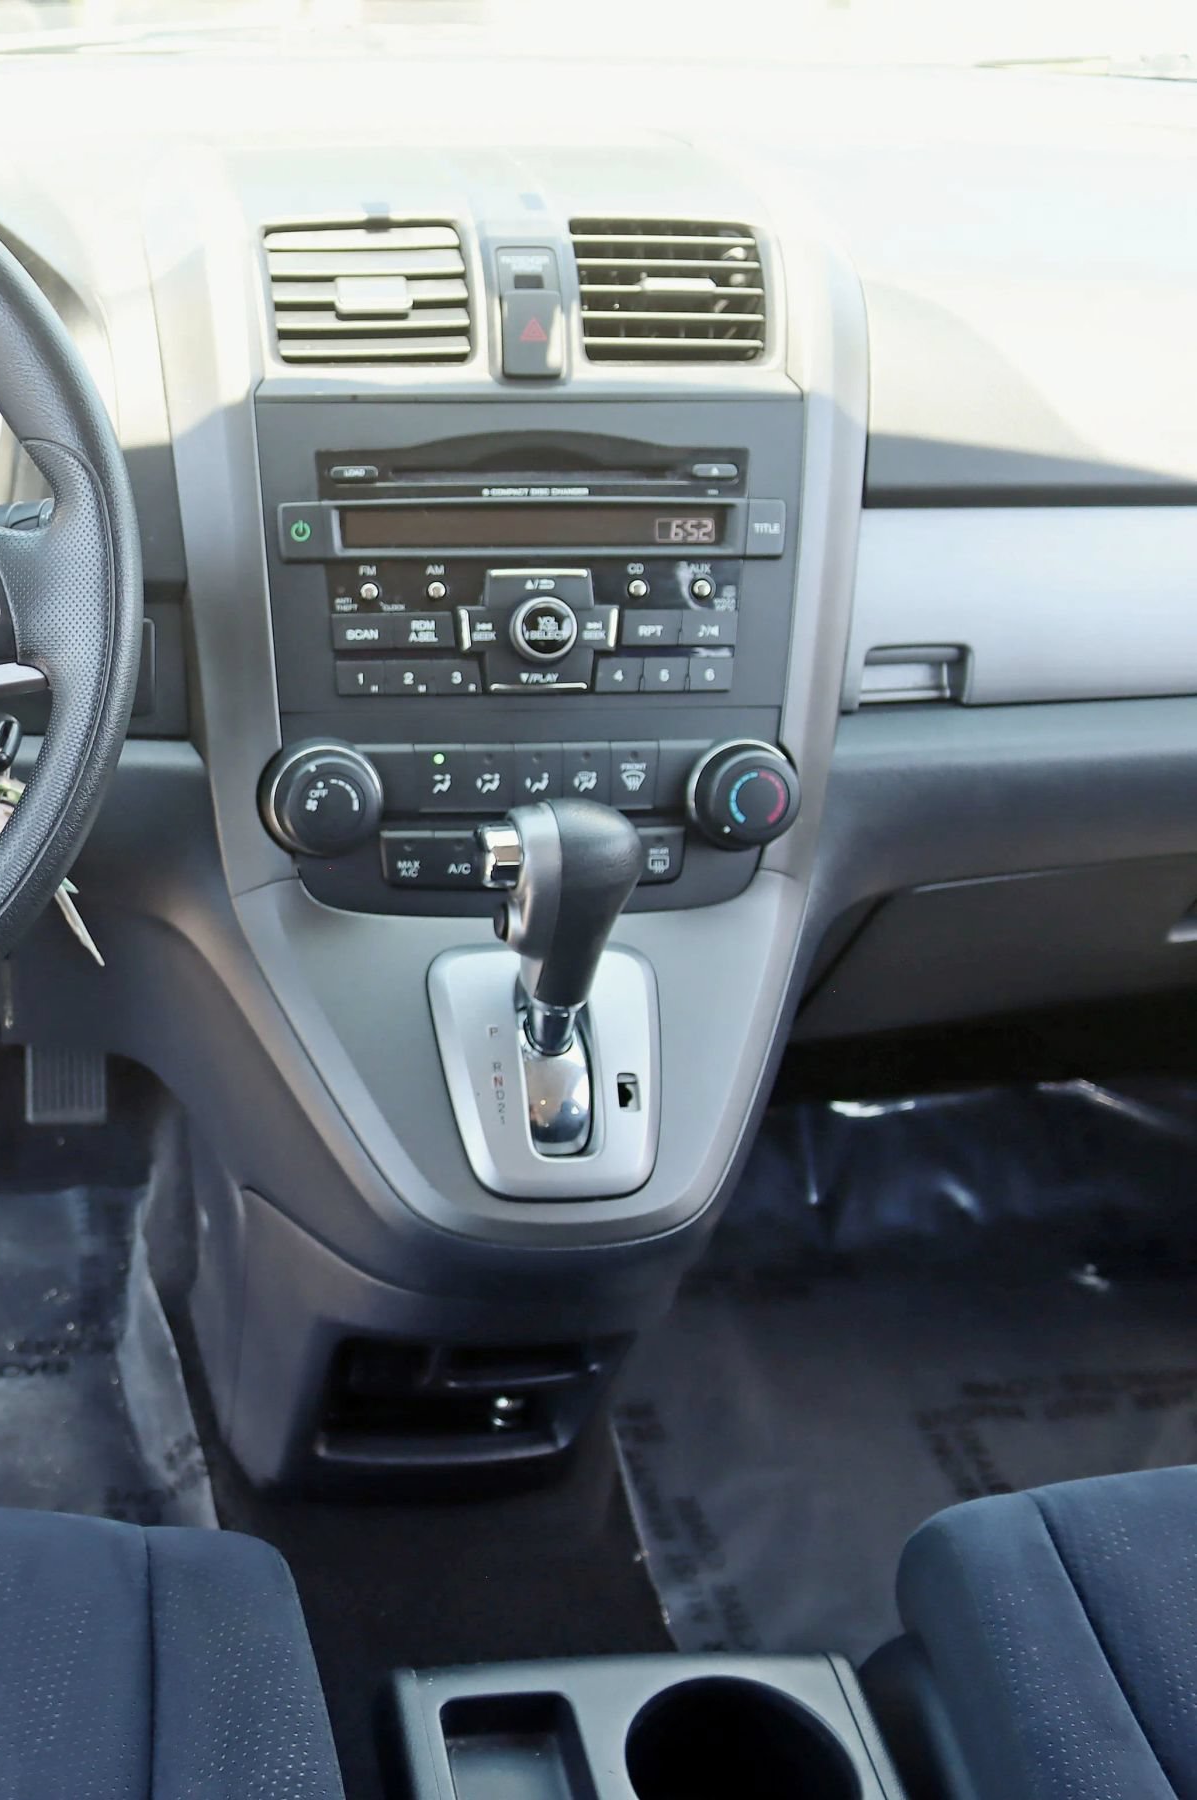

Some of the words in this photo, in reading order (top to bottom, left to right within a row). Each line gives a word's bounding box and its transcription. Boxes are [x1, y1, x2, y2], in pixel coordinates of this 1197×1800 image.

[753, 522, 781, 534] TITLE
[359, 564, 377, 577] FM
[425, 564, 445, 576] AM
[627, 563, 645, 575] CD
[690, 564, 712, 575] AUX
[411, 619, 435, 630] RDM
[346, 629, 379, 641] SCAN
[639, 625, 664, 637] RPT
[357, 672, 364, 685] 1
[403, 672, 414, 685] 2
[452, 671, 463, 684] 3
[613, 669, 623, 681] 4
[705, 669, 715, 681] 6
[310, 788, 329, 798] OFF
[397, 860, 421, 869] MAX
[448, 863, 471, 875] A/C
[400, 868, 419, 878] A/C
[489, 1027, 498, 1037] P
[493, 1062, 501, 1072] R
[494, 1076, 502, 1087] N
